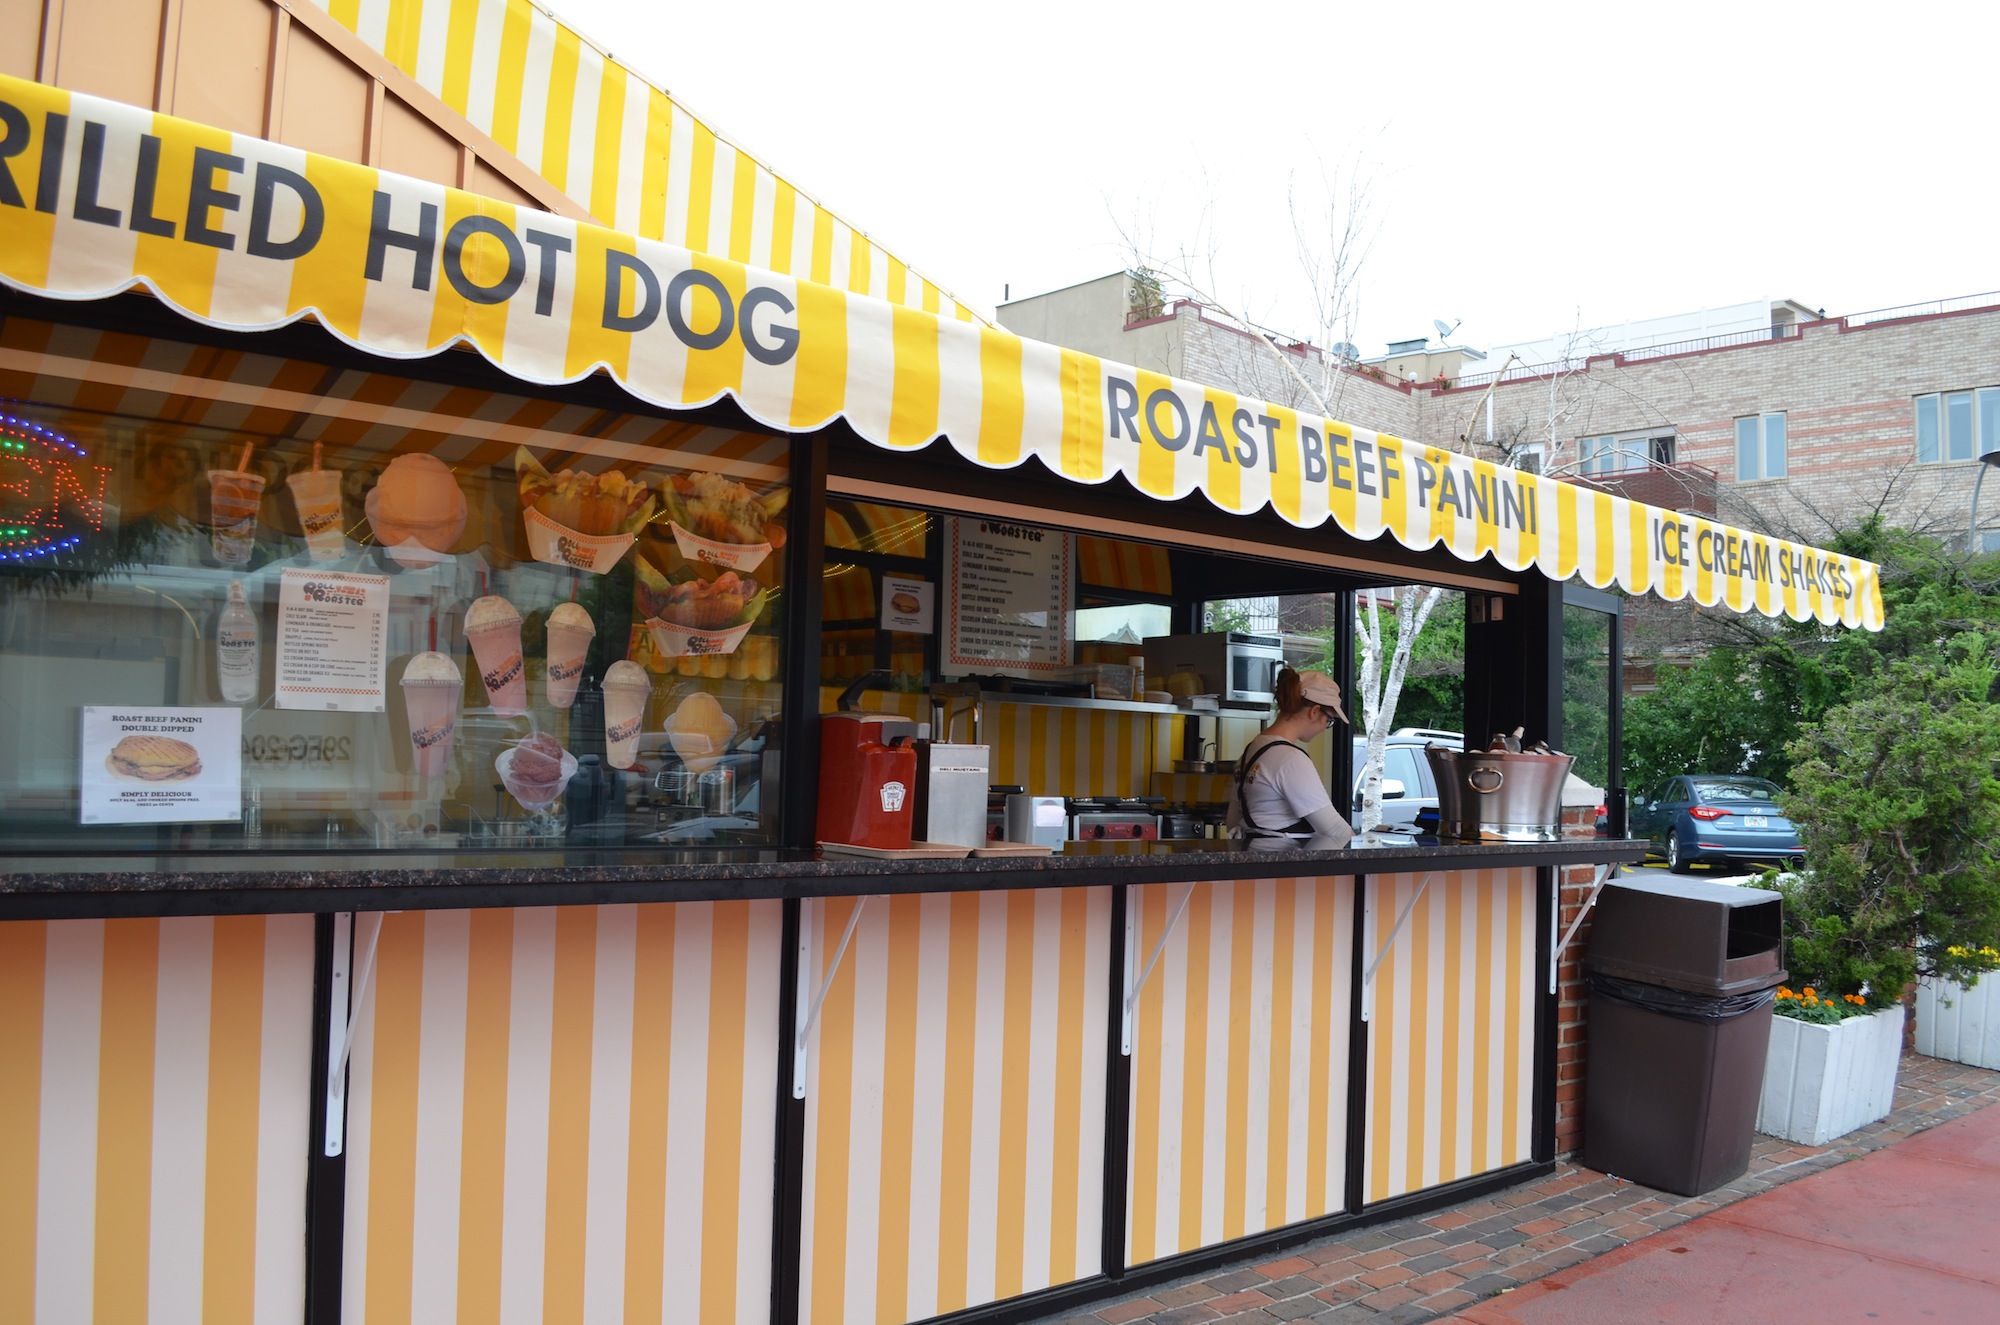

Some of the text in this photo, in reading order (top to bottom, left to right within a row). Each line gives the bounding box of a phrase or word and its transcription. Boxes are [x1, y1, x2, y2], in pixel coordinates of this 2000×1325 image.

[0, 100, 800, 366] RILLED HOT DOG
[1107, 375, 1538, 535] ROAST BEEF PANINI
[312, 589, 364, 606] ROASTER
[1654, 518, 1852, 600] ICE CREAM SHAKES
